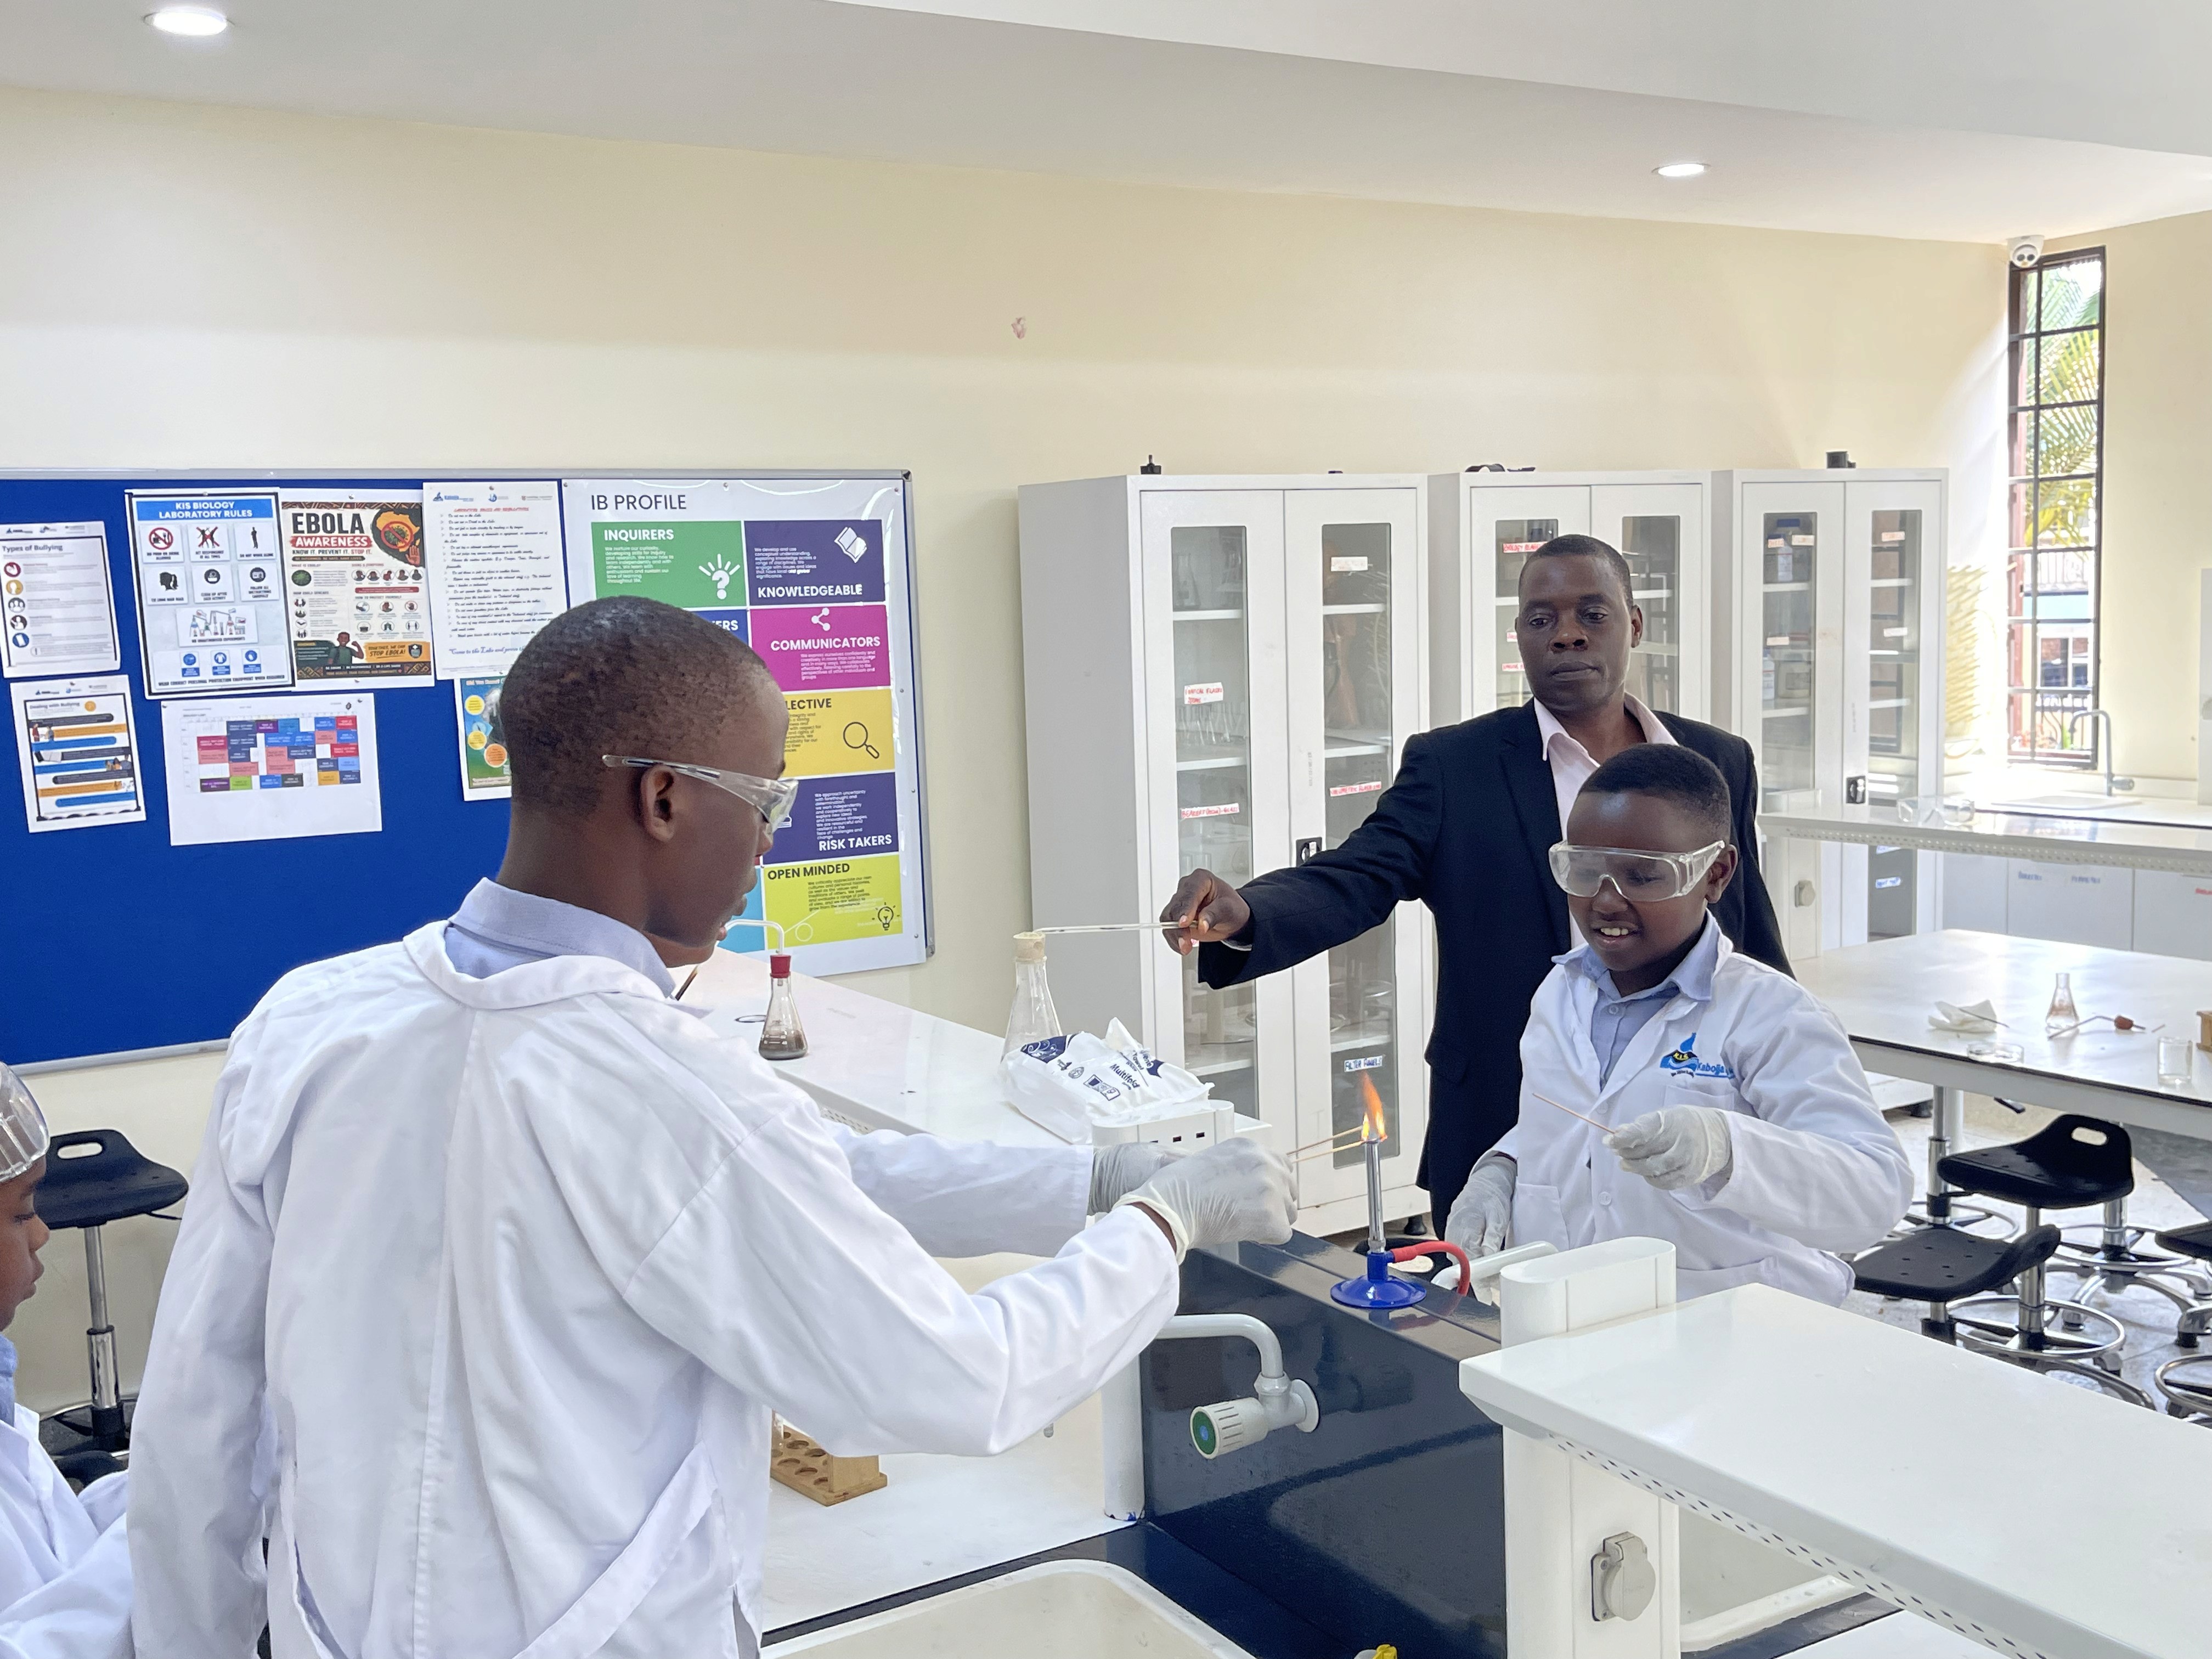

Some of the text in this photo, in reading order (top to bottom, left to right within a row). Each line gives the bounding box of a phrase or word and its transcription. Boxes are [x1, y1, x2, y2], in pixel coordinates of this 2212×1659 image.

[193, 501, 234, 510] BIOLOGY
[591, 495, 687, 510] IB PROFILE
[159, 511, 222, 519] LABORATORY
[291, 512, 365, 534] EBOLA
[296, 537, 368, 547] AWARENESS
[604, 529, 674, 542] INQUIRERS
[758, 584, 862, 597] KNOWLEDGEABLE
[771, 636, 881, 651] COMMUNICATORS
[786, 698, 832, 710] LECTIVE
[819, 834, 892, 851] RISK TAKERS
[768, 863, 850, 881] OPEN MINDED
[1110, 1064, 1140, 1088] Multifold
